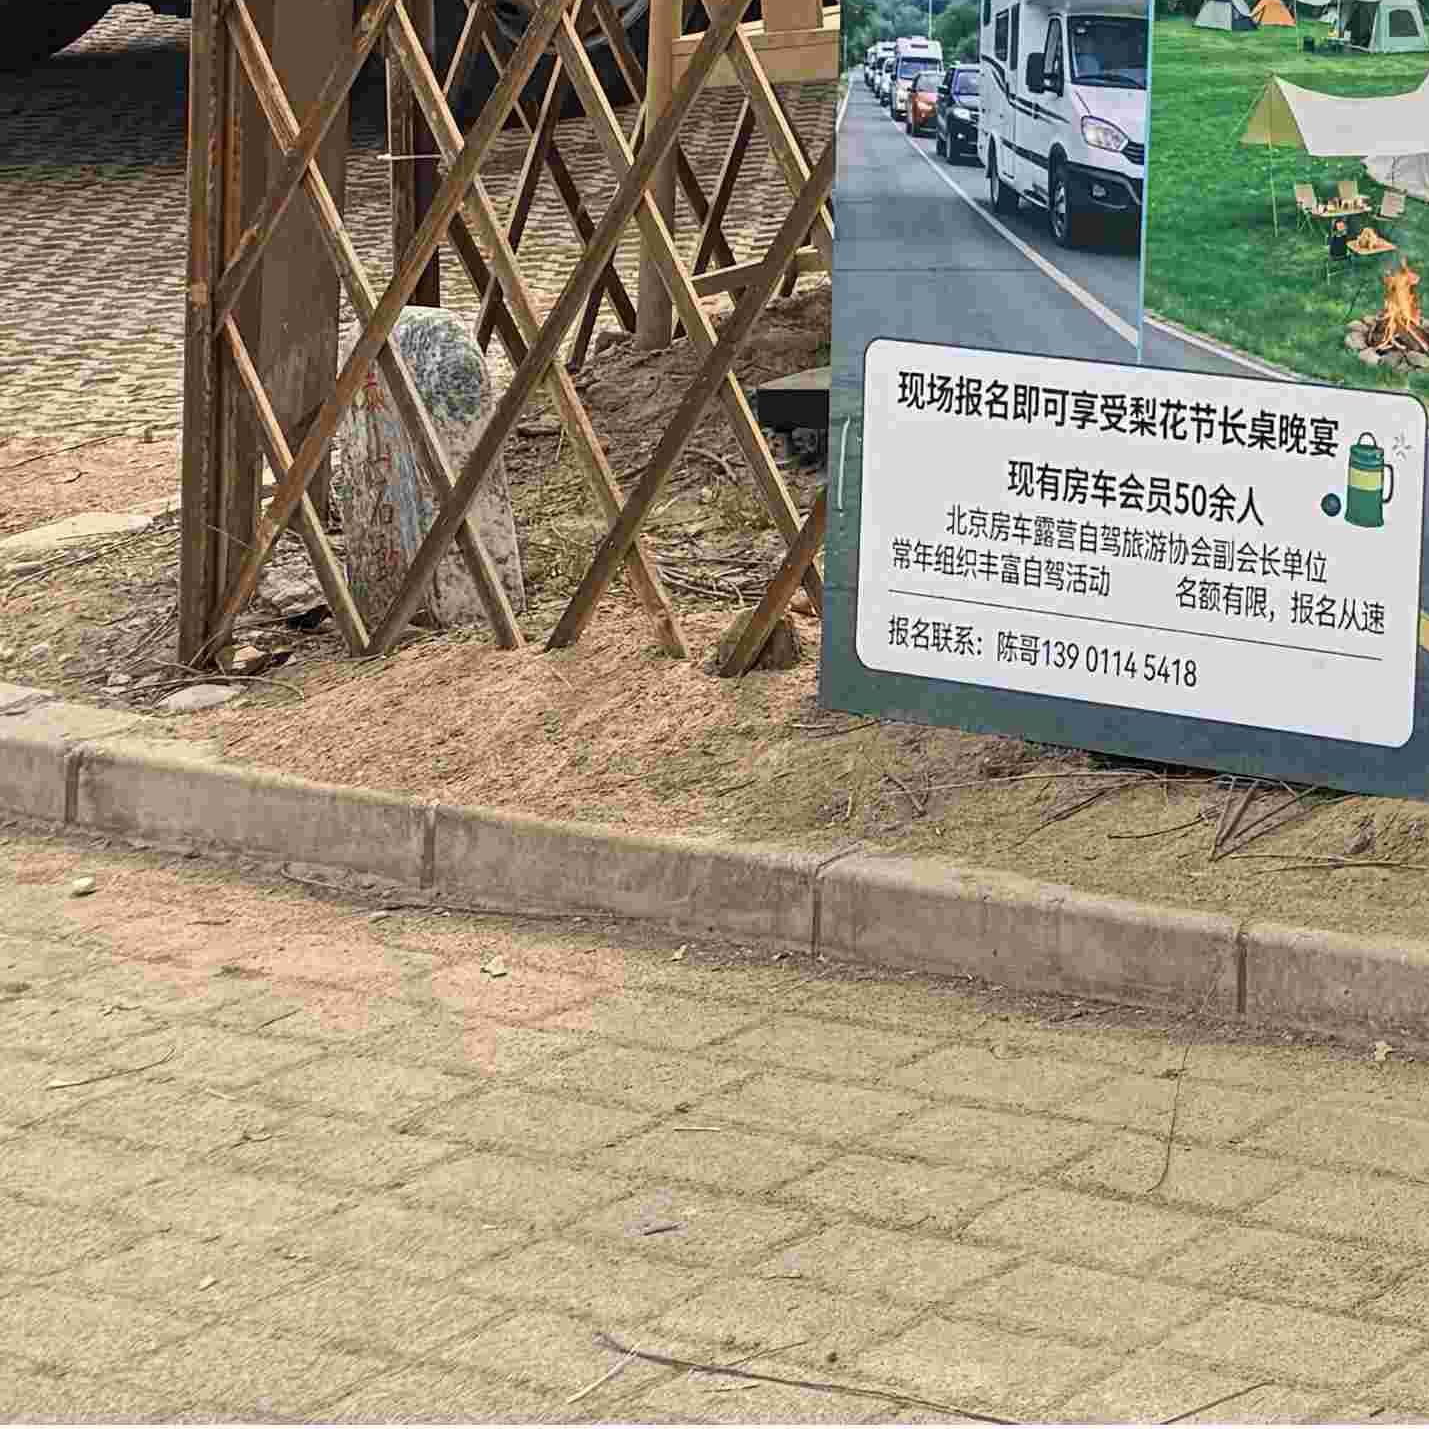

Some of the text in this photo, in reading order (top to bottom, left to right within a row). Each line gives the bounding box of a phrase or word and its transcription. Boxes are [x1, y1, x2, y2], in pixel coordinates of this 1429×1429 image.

[896, 369, 1340, 459] 现场报名即可享受梨花节长桌晚宴
[1007, 459, 1266, 528] 现有房车会员50余人
[891, 538, 1111, 599] 常年组织丰富自驾活动
[945, 504, 1328, 585] 北京房车露营自驾旅游协会副会长单位
[1084, 644, 1138, 679] 0114
[1142, 650, 1198, 688] 5418
